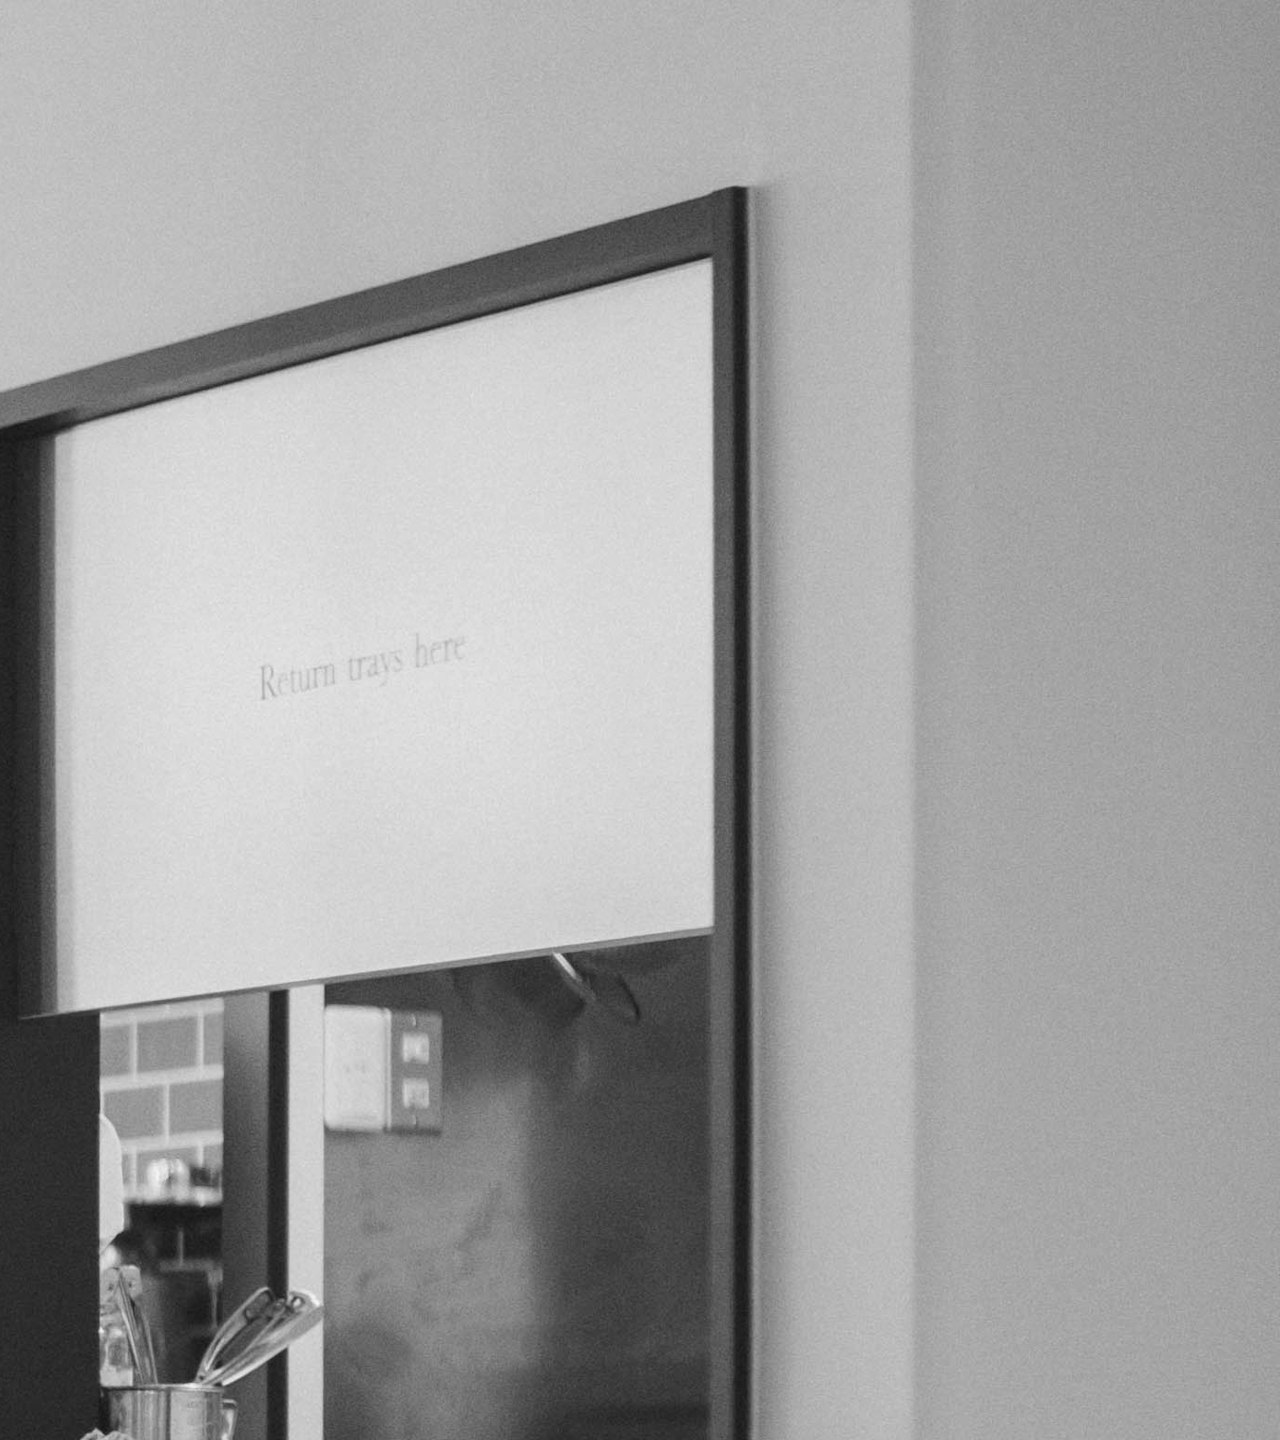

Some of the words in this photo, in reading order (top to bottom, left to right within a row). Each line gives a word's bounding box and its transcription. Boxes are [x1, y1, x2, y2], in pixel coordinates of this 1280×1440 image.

[260, 663, 336, 700] Return
[348, 650, 403, 687] trays
[416, 632, 466, 668] here
